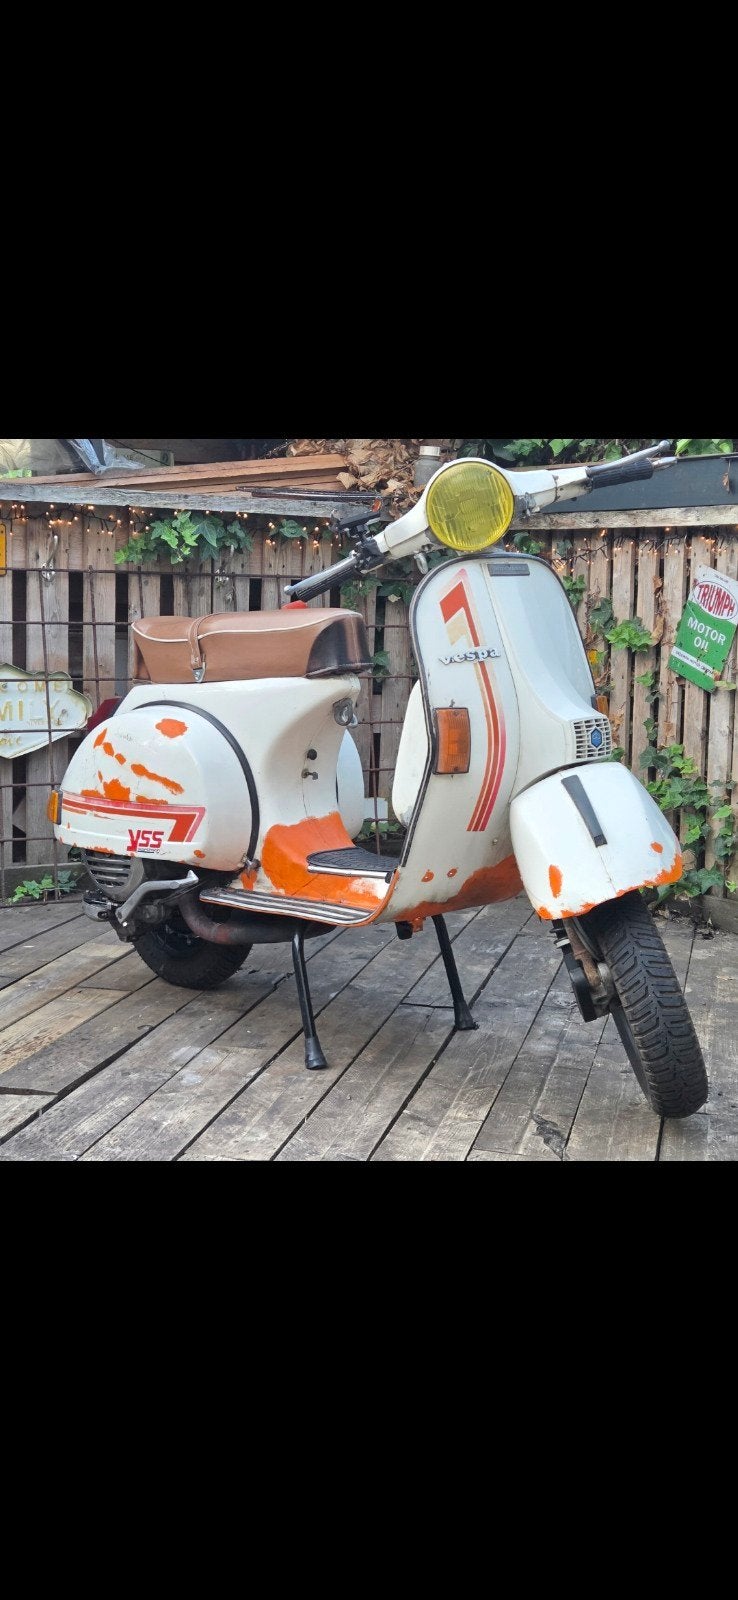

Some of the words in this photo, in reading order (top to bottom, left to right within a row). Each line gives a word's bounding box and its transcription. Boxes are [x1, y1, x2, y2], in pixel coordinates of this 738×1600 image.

[697, 584, 736, 617] TRIUMPH
[687, 616, 726, 646] MOTOR
[693, 636, 709, 650] OIL
